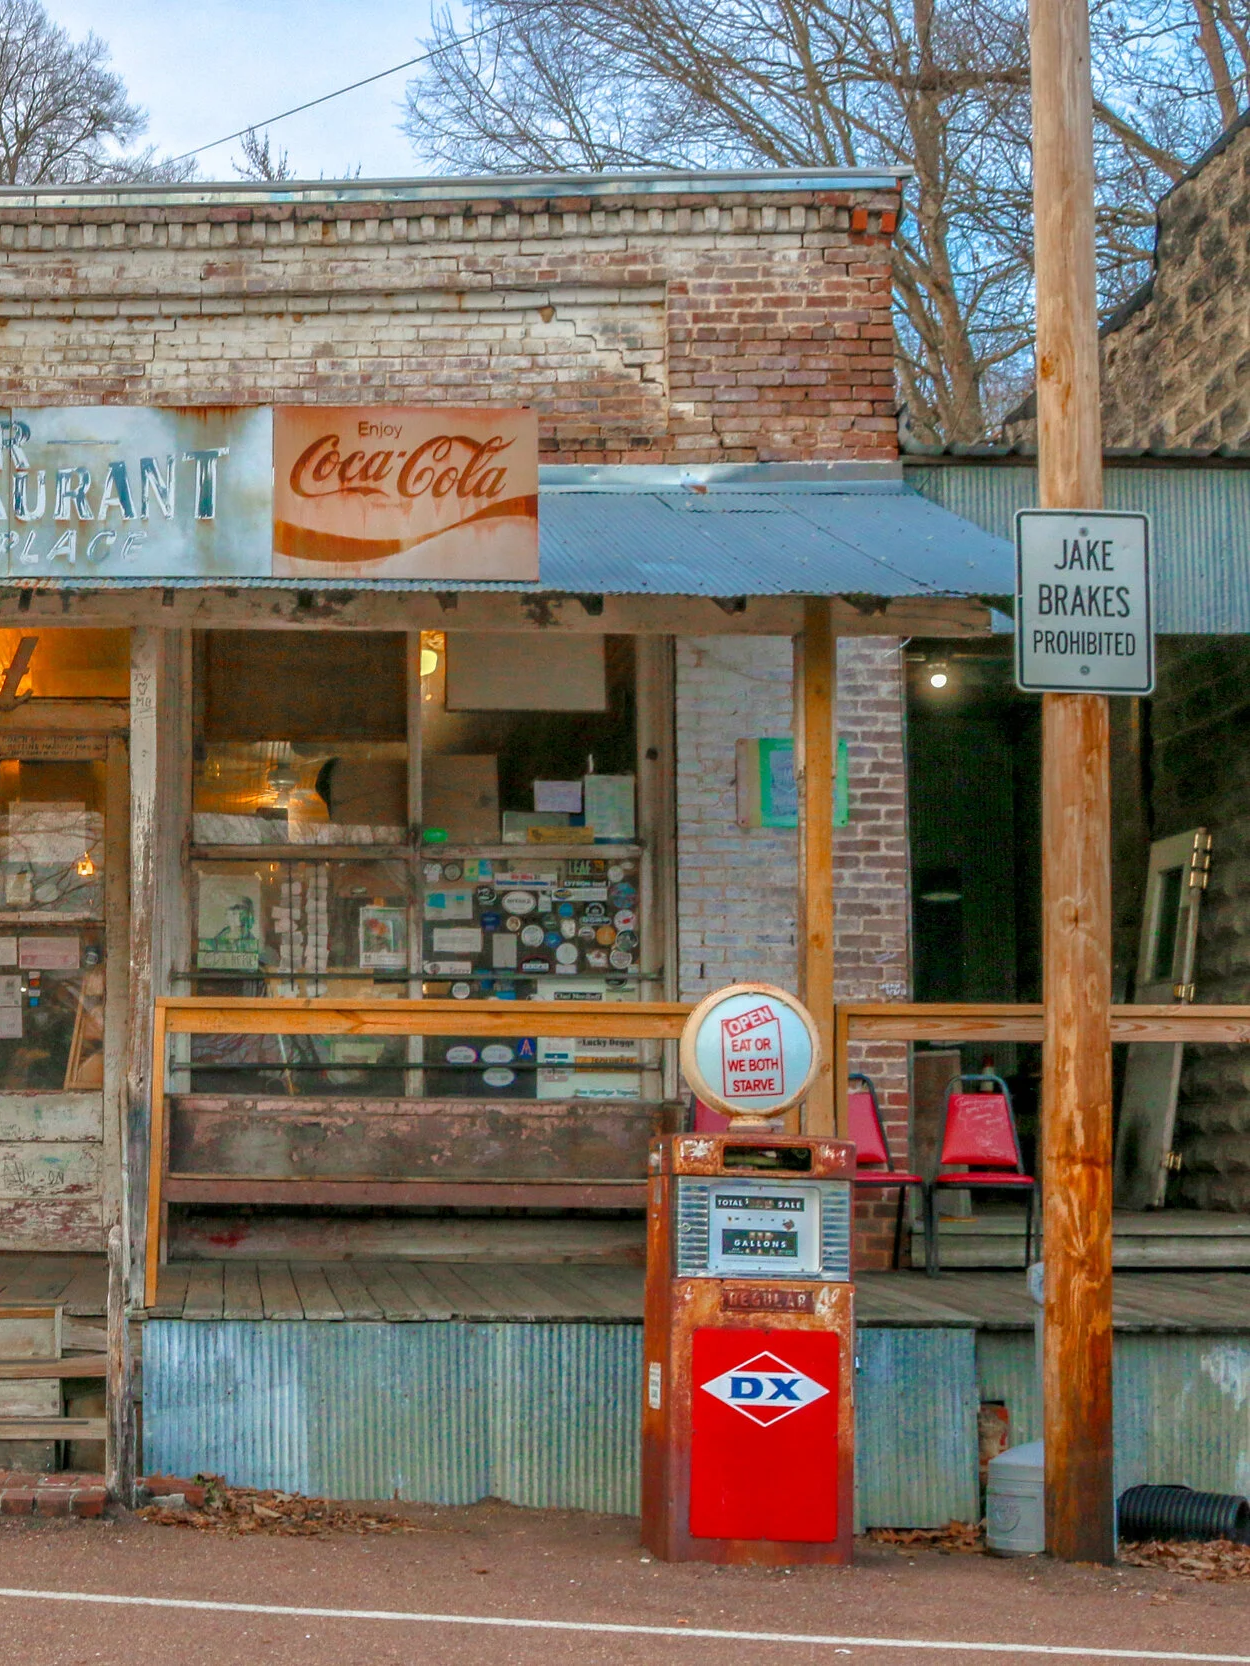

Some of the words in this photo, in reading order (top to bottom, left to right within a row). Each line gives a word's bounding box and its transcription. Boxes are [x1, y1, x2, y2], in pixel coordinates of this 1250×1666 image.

[358, 421, 403, 439] Enjoy
[289, 434, 517, 499] Coca-Cola
[1054, 539, 1114, 571] JAKE
[1038, 584, 1130, 618] BRAKES
[1033, 630, 1136, 656] PROHIBITED
[728, 1010, 774, 1034] OPEN
[731, 1038, 751, 1052] EAT
[755, 1038, 772, 1050] OR
[728, 1059, 745, 1072] WE
[749, 1058, 779, 1071] BOTH
[733, 1079, 775, 1092] STARVE
[718, 1199, 743, 1207] TOTAL
[734, 1239, 787, 1248] GALLONS
[729, 1291, 807, 1308] REGULAR
[728, 1376, 803, 1401] DX
